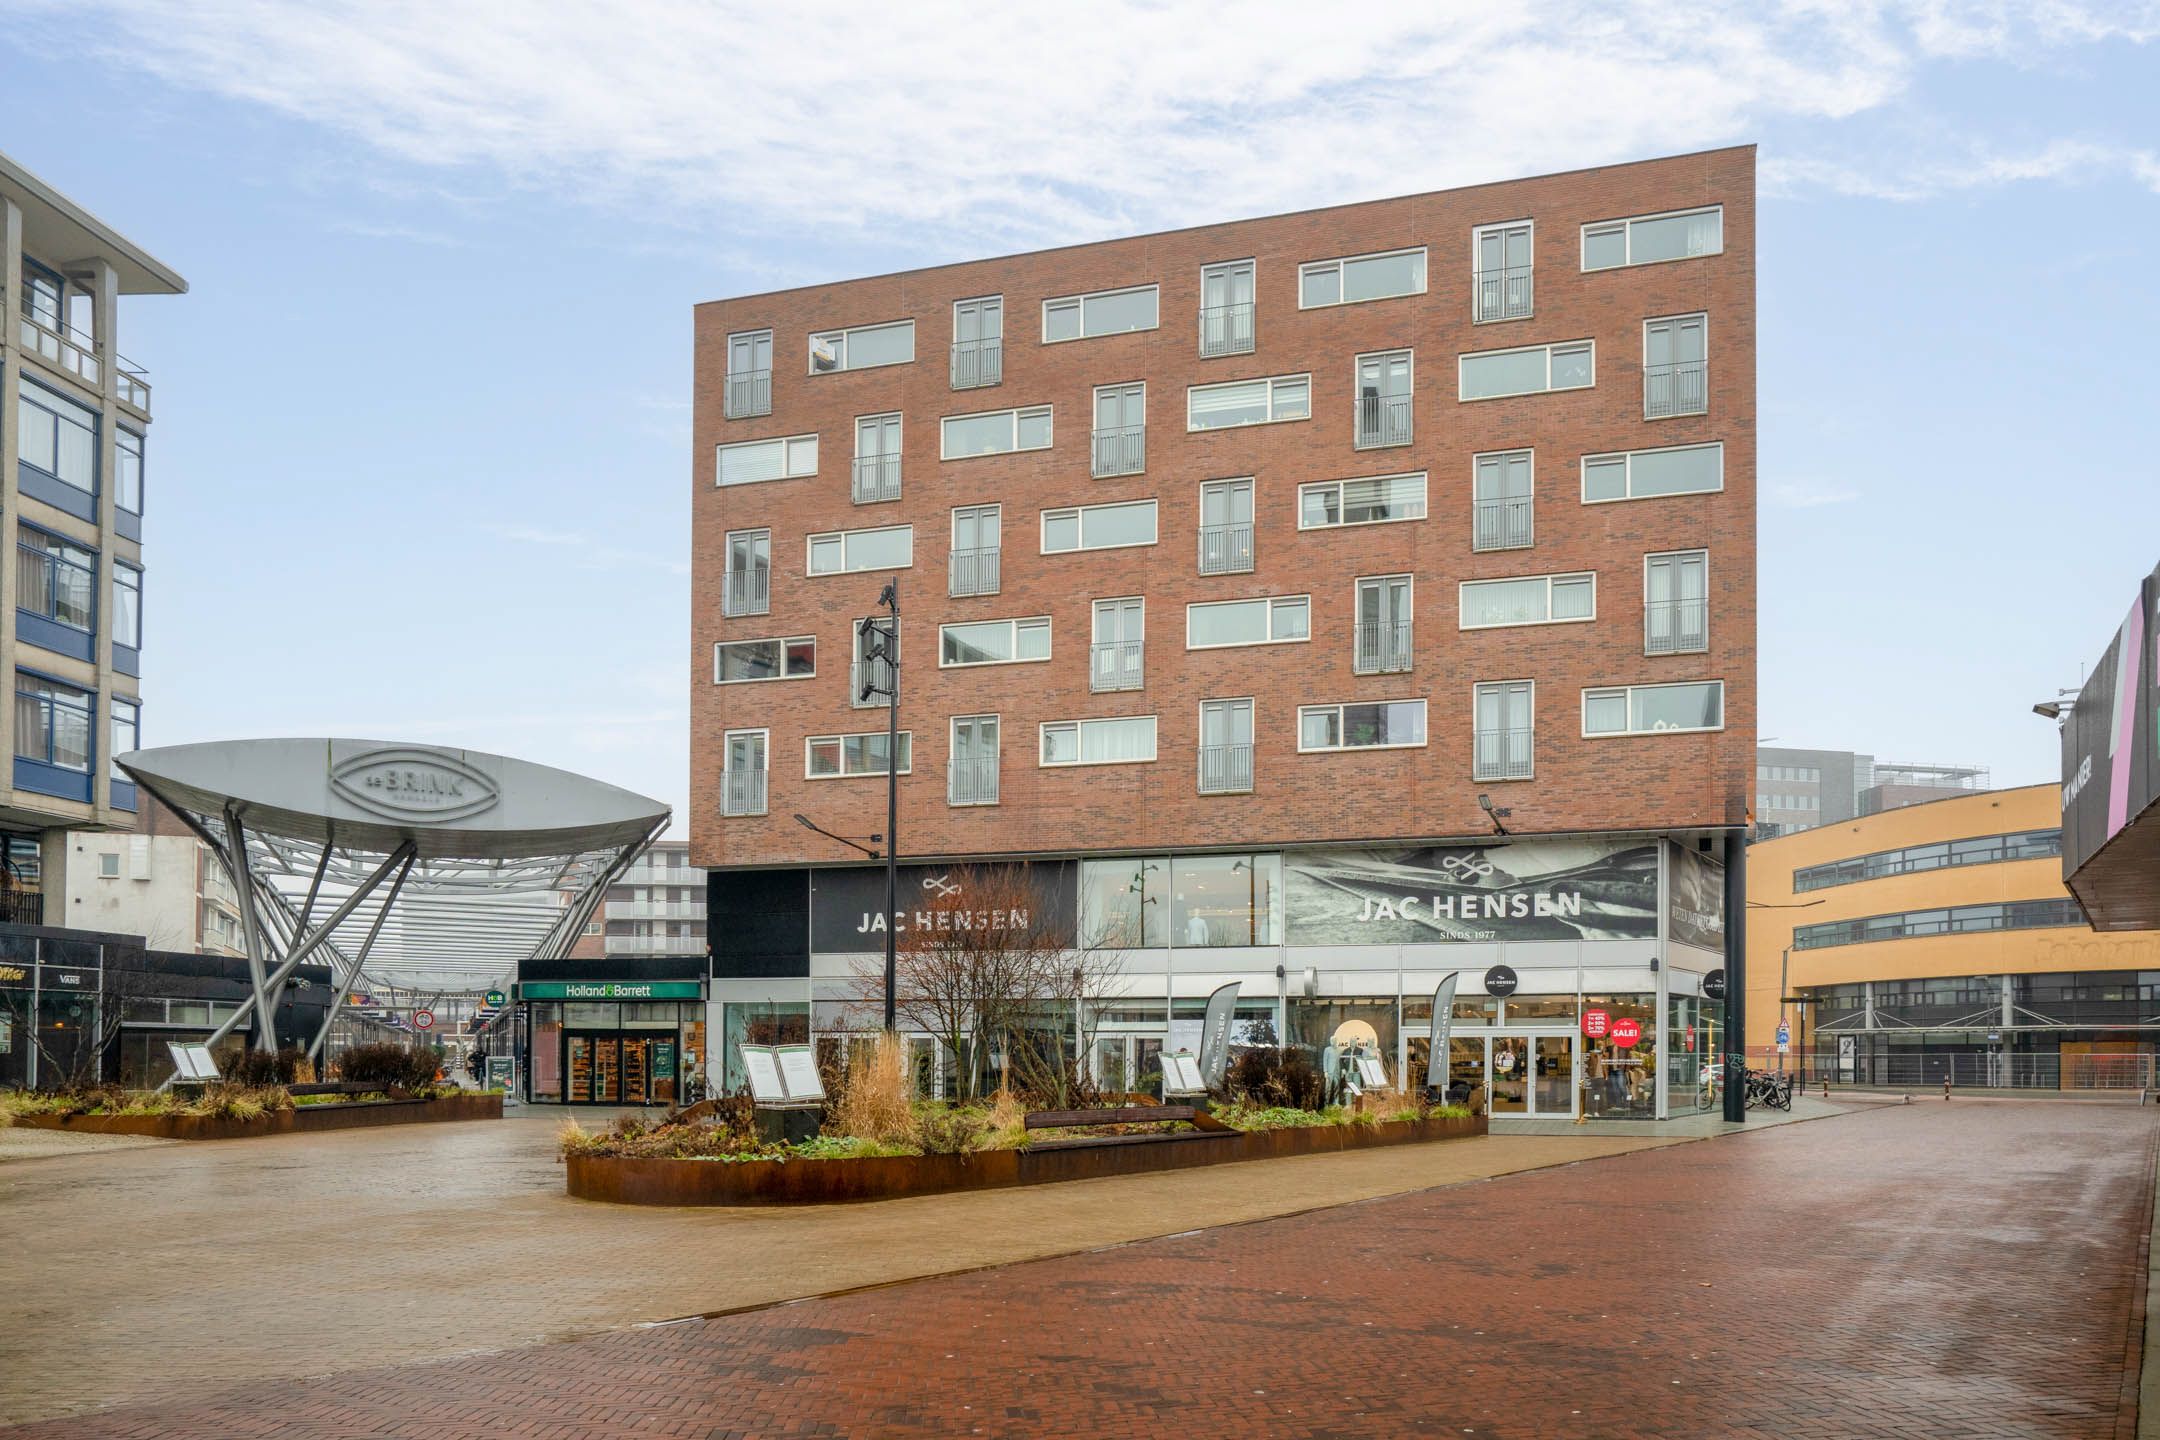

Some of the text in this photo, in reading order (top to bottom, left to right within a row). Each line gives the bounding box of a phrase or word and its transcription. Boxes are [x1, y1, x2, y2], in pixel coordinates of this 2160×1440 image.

[386, 769, 466, 798] BRINK
[1357, 892, 1581, 922] JAC HENSEN
[915, 909, 1028, 932] HENSEN
[1439, 930, 1496, 940] SINDS 1977
[59, 974, 80, 985] VANS
[1613, 1029, 1638, 1037] SALE!
